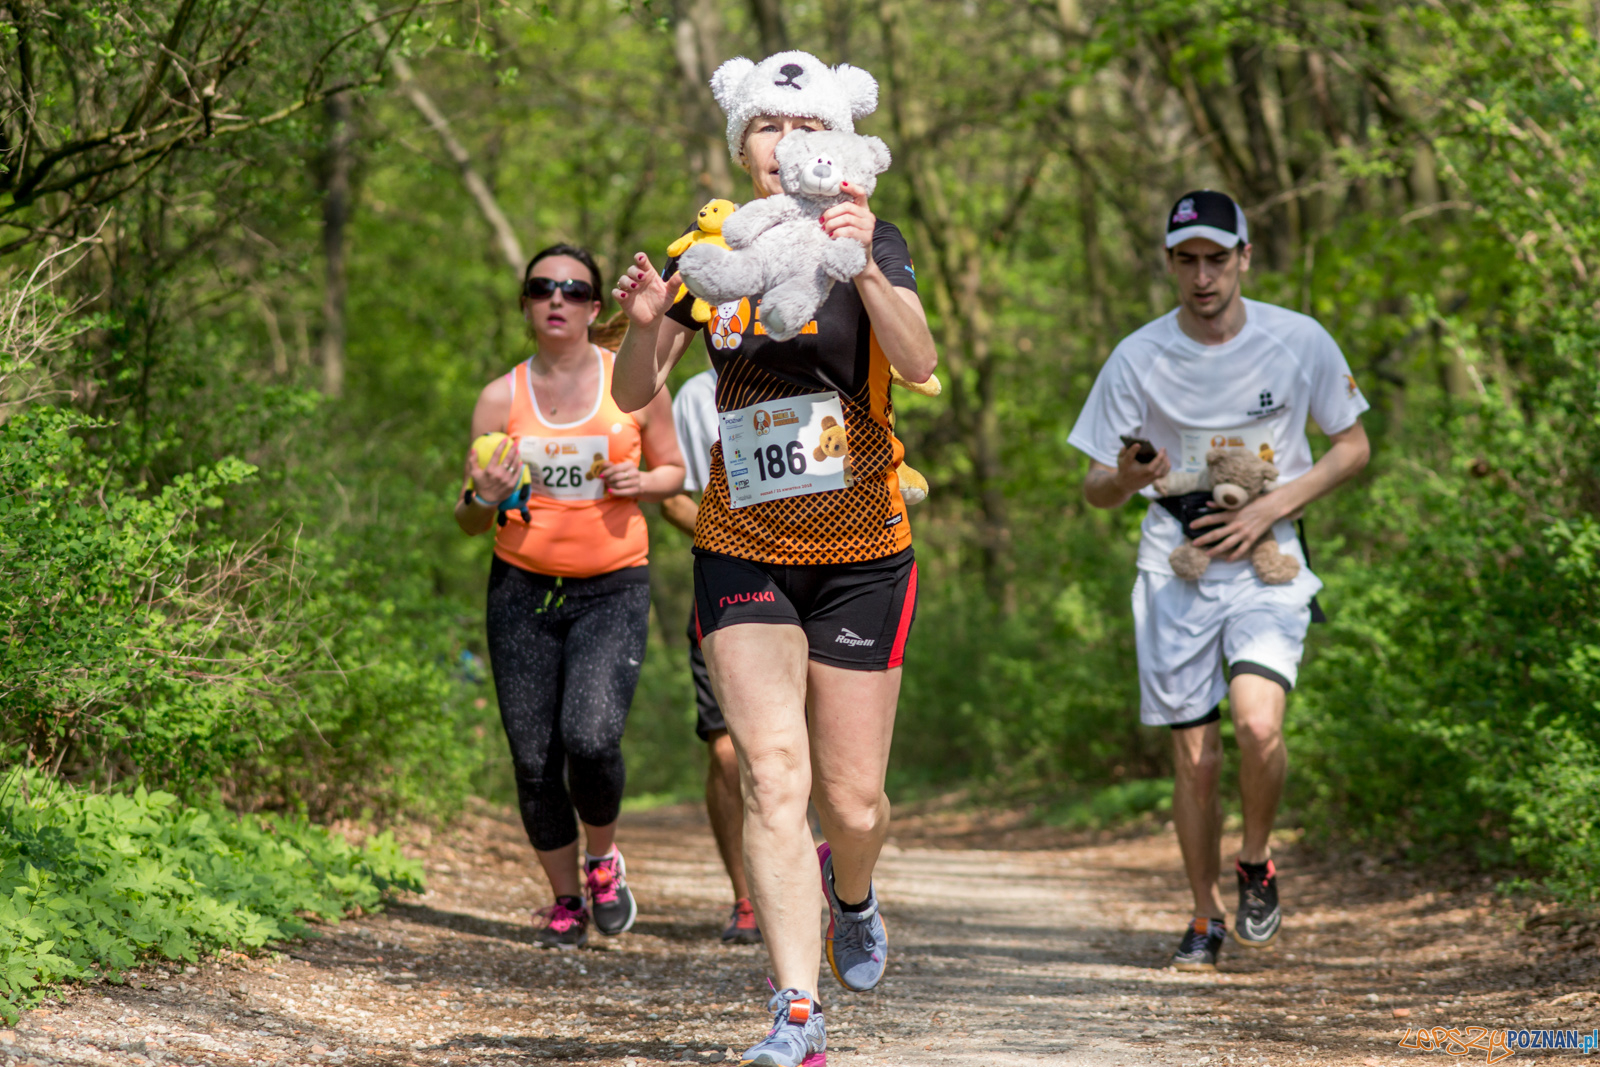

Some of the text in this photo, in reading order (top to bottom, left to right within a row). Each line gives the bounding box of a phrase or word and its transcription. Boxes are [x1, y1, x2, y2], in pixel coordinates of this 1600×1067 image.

[753, 440, 807, 481] 186
[542, 466, 582, 487] 226
[835, 634, 876, 647] Rogelli
